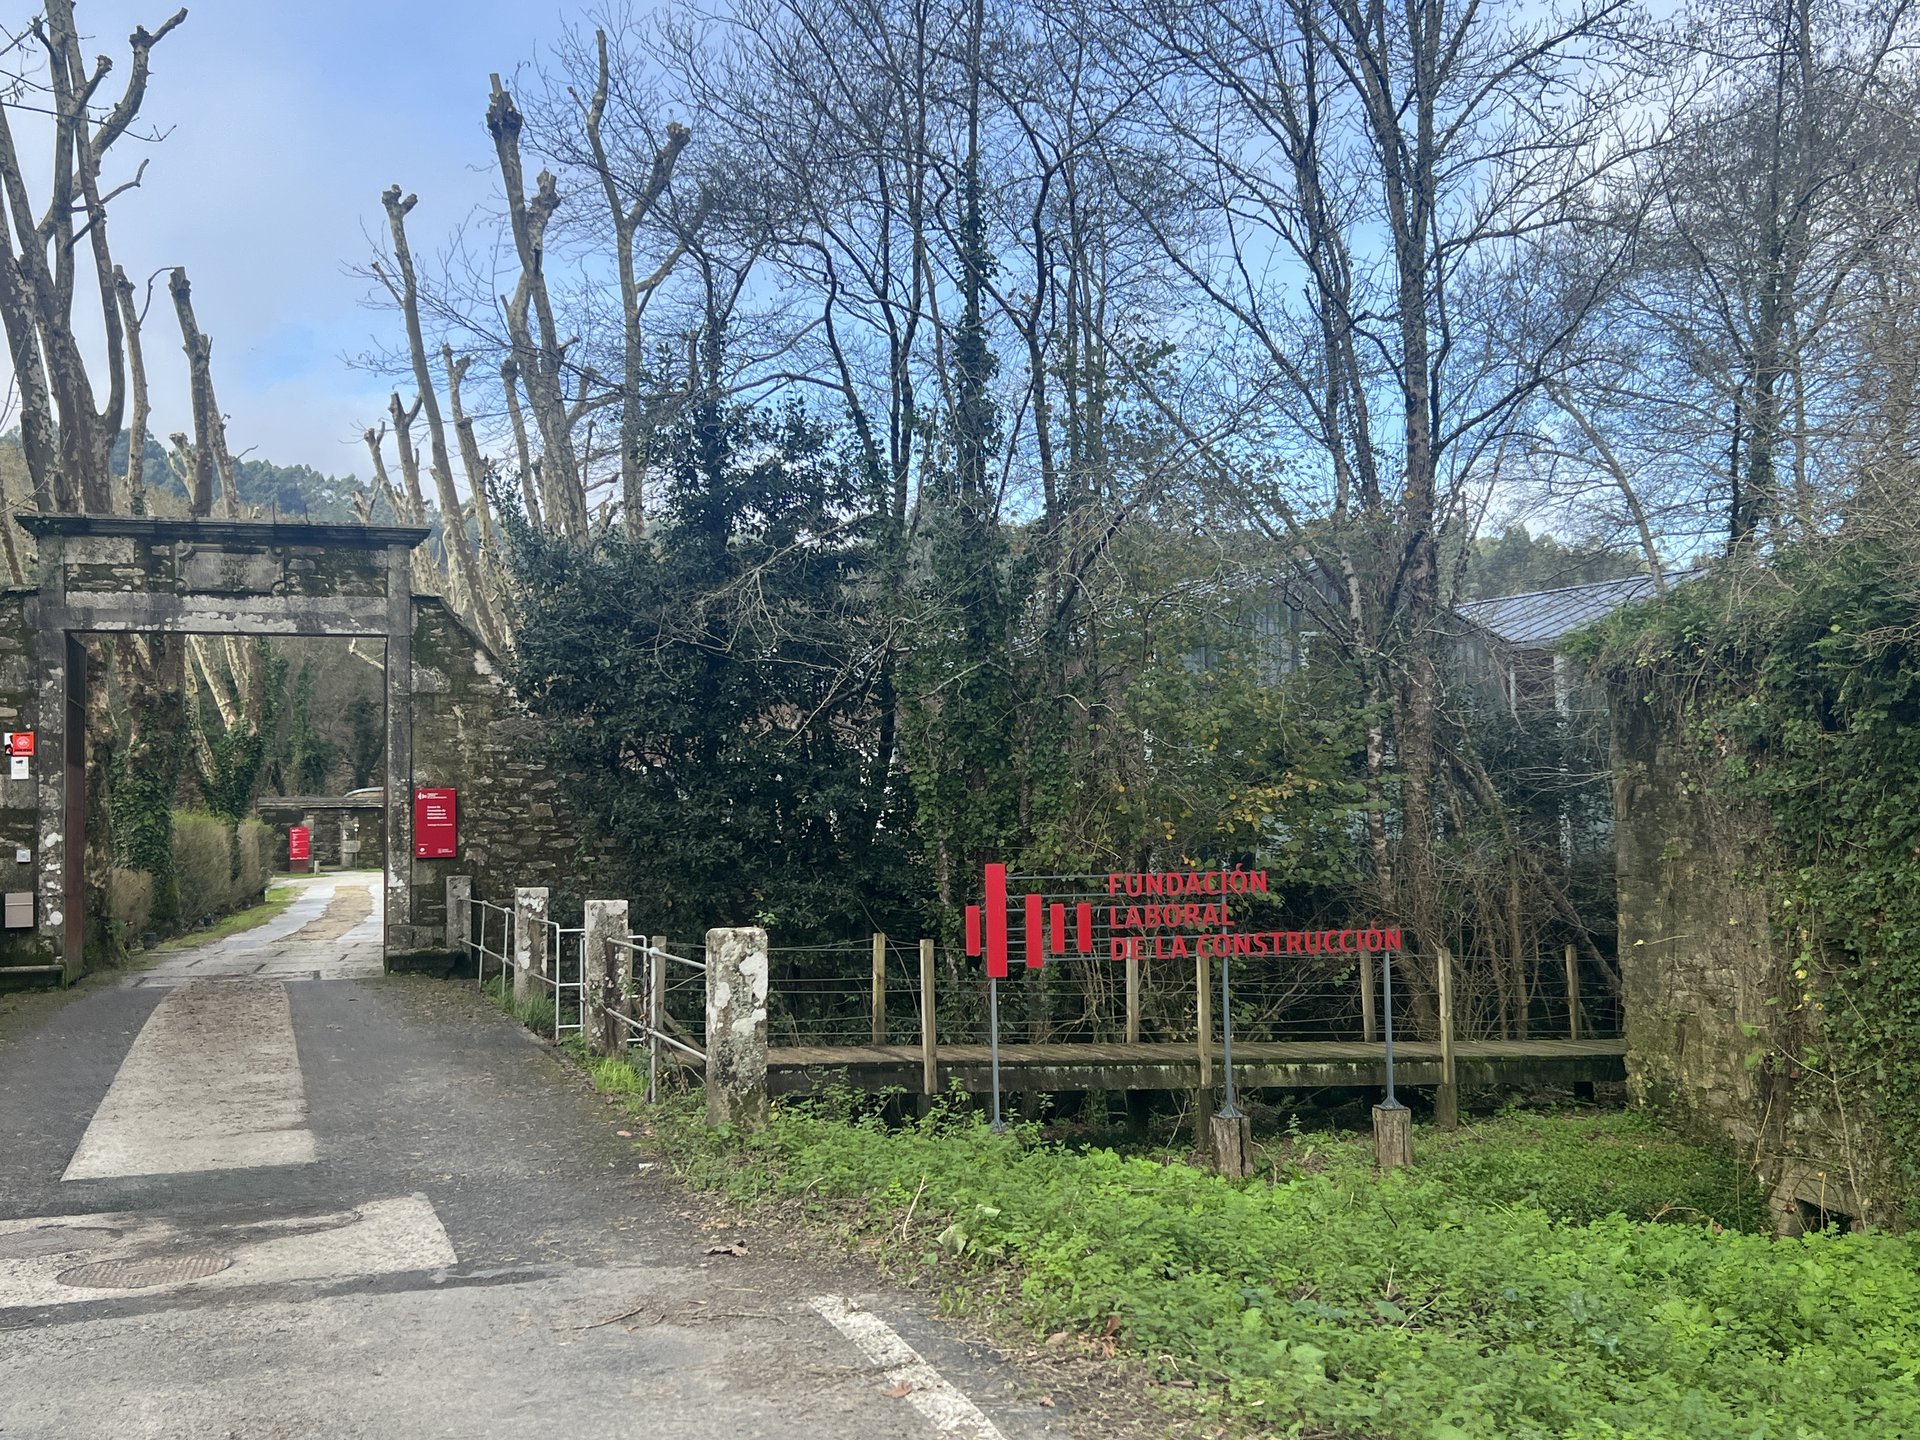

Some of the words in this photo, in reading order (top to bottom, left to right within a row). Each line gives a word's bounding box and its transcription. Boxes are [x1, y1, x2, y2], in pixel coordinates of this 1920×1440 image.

[1109, 863, 1267, 897] FUNDACIÓN
[1110, 903, 1235, 929] LABORAL
[1110, 937, 1146, 961] DE
[1155, 935, 1188, 960] LA
[1196, 920, 1402, 958] CONSTRUCCIÓN
